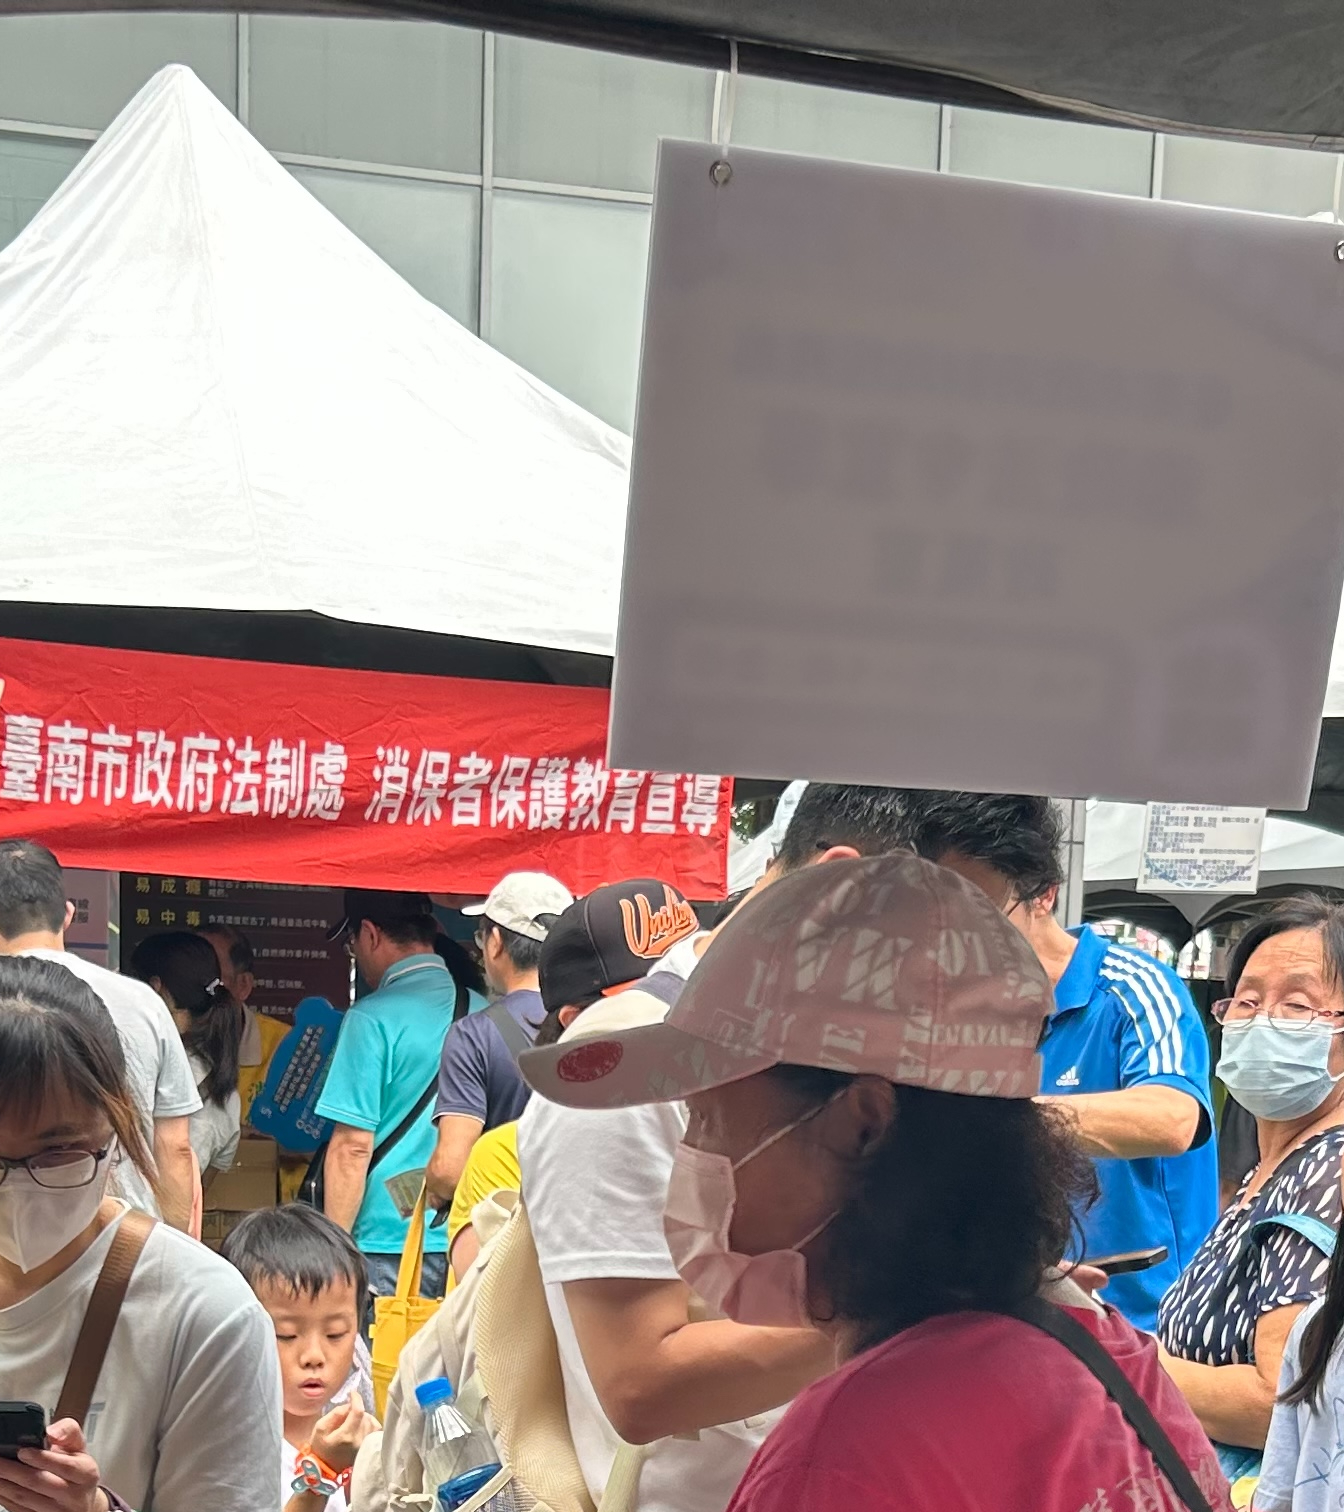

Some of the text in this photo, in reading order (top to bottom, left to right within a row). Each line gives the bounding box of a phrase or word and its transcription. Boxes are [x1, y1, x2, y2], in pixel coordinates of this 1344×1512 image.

[0, 715, 348, 822] 臺南市政府法制處
[136, 909, 202, 927] 易中毒
